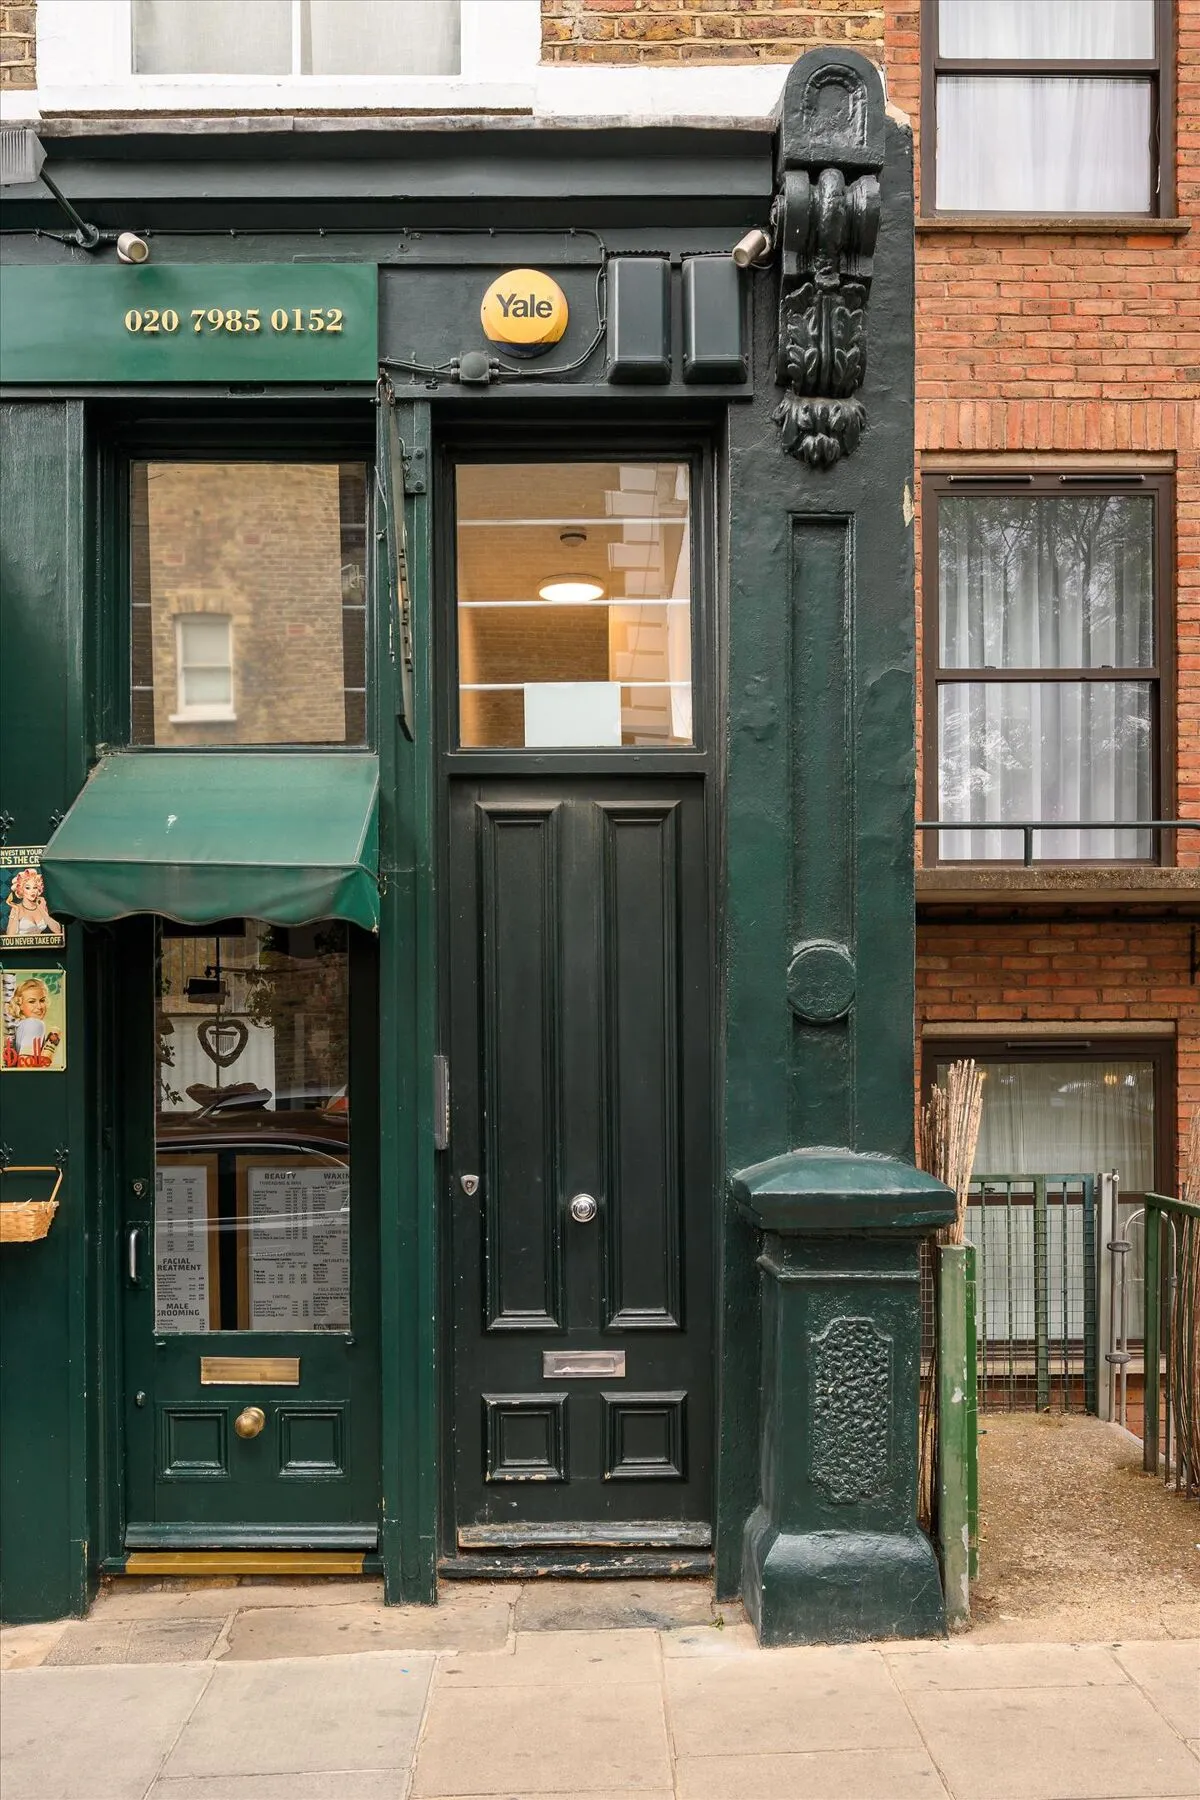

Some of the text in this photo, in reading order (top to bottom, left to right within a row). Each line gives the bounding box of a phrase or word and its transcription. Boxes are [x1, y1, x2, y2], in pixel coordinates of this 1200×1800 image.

[496, 293, 553, 319] Yale
[124, 308, 344, 334] 020 7985 0152
[0, 856, 13, 865] T'S
[13, 856, 28, 865] THE
[1, 936, 61, 946] YOU NEVER TAKE OFF
[264, 1172, 297, 1180] BEAUTY
[162, 1257, 191, 1265] FACIAL
